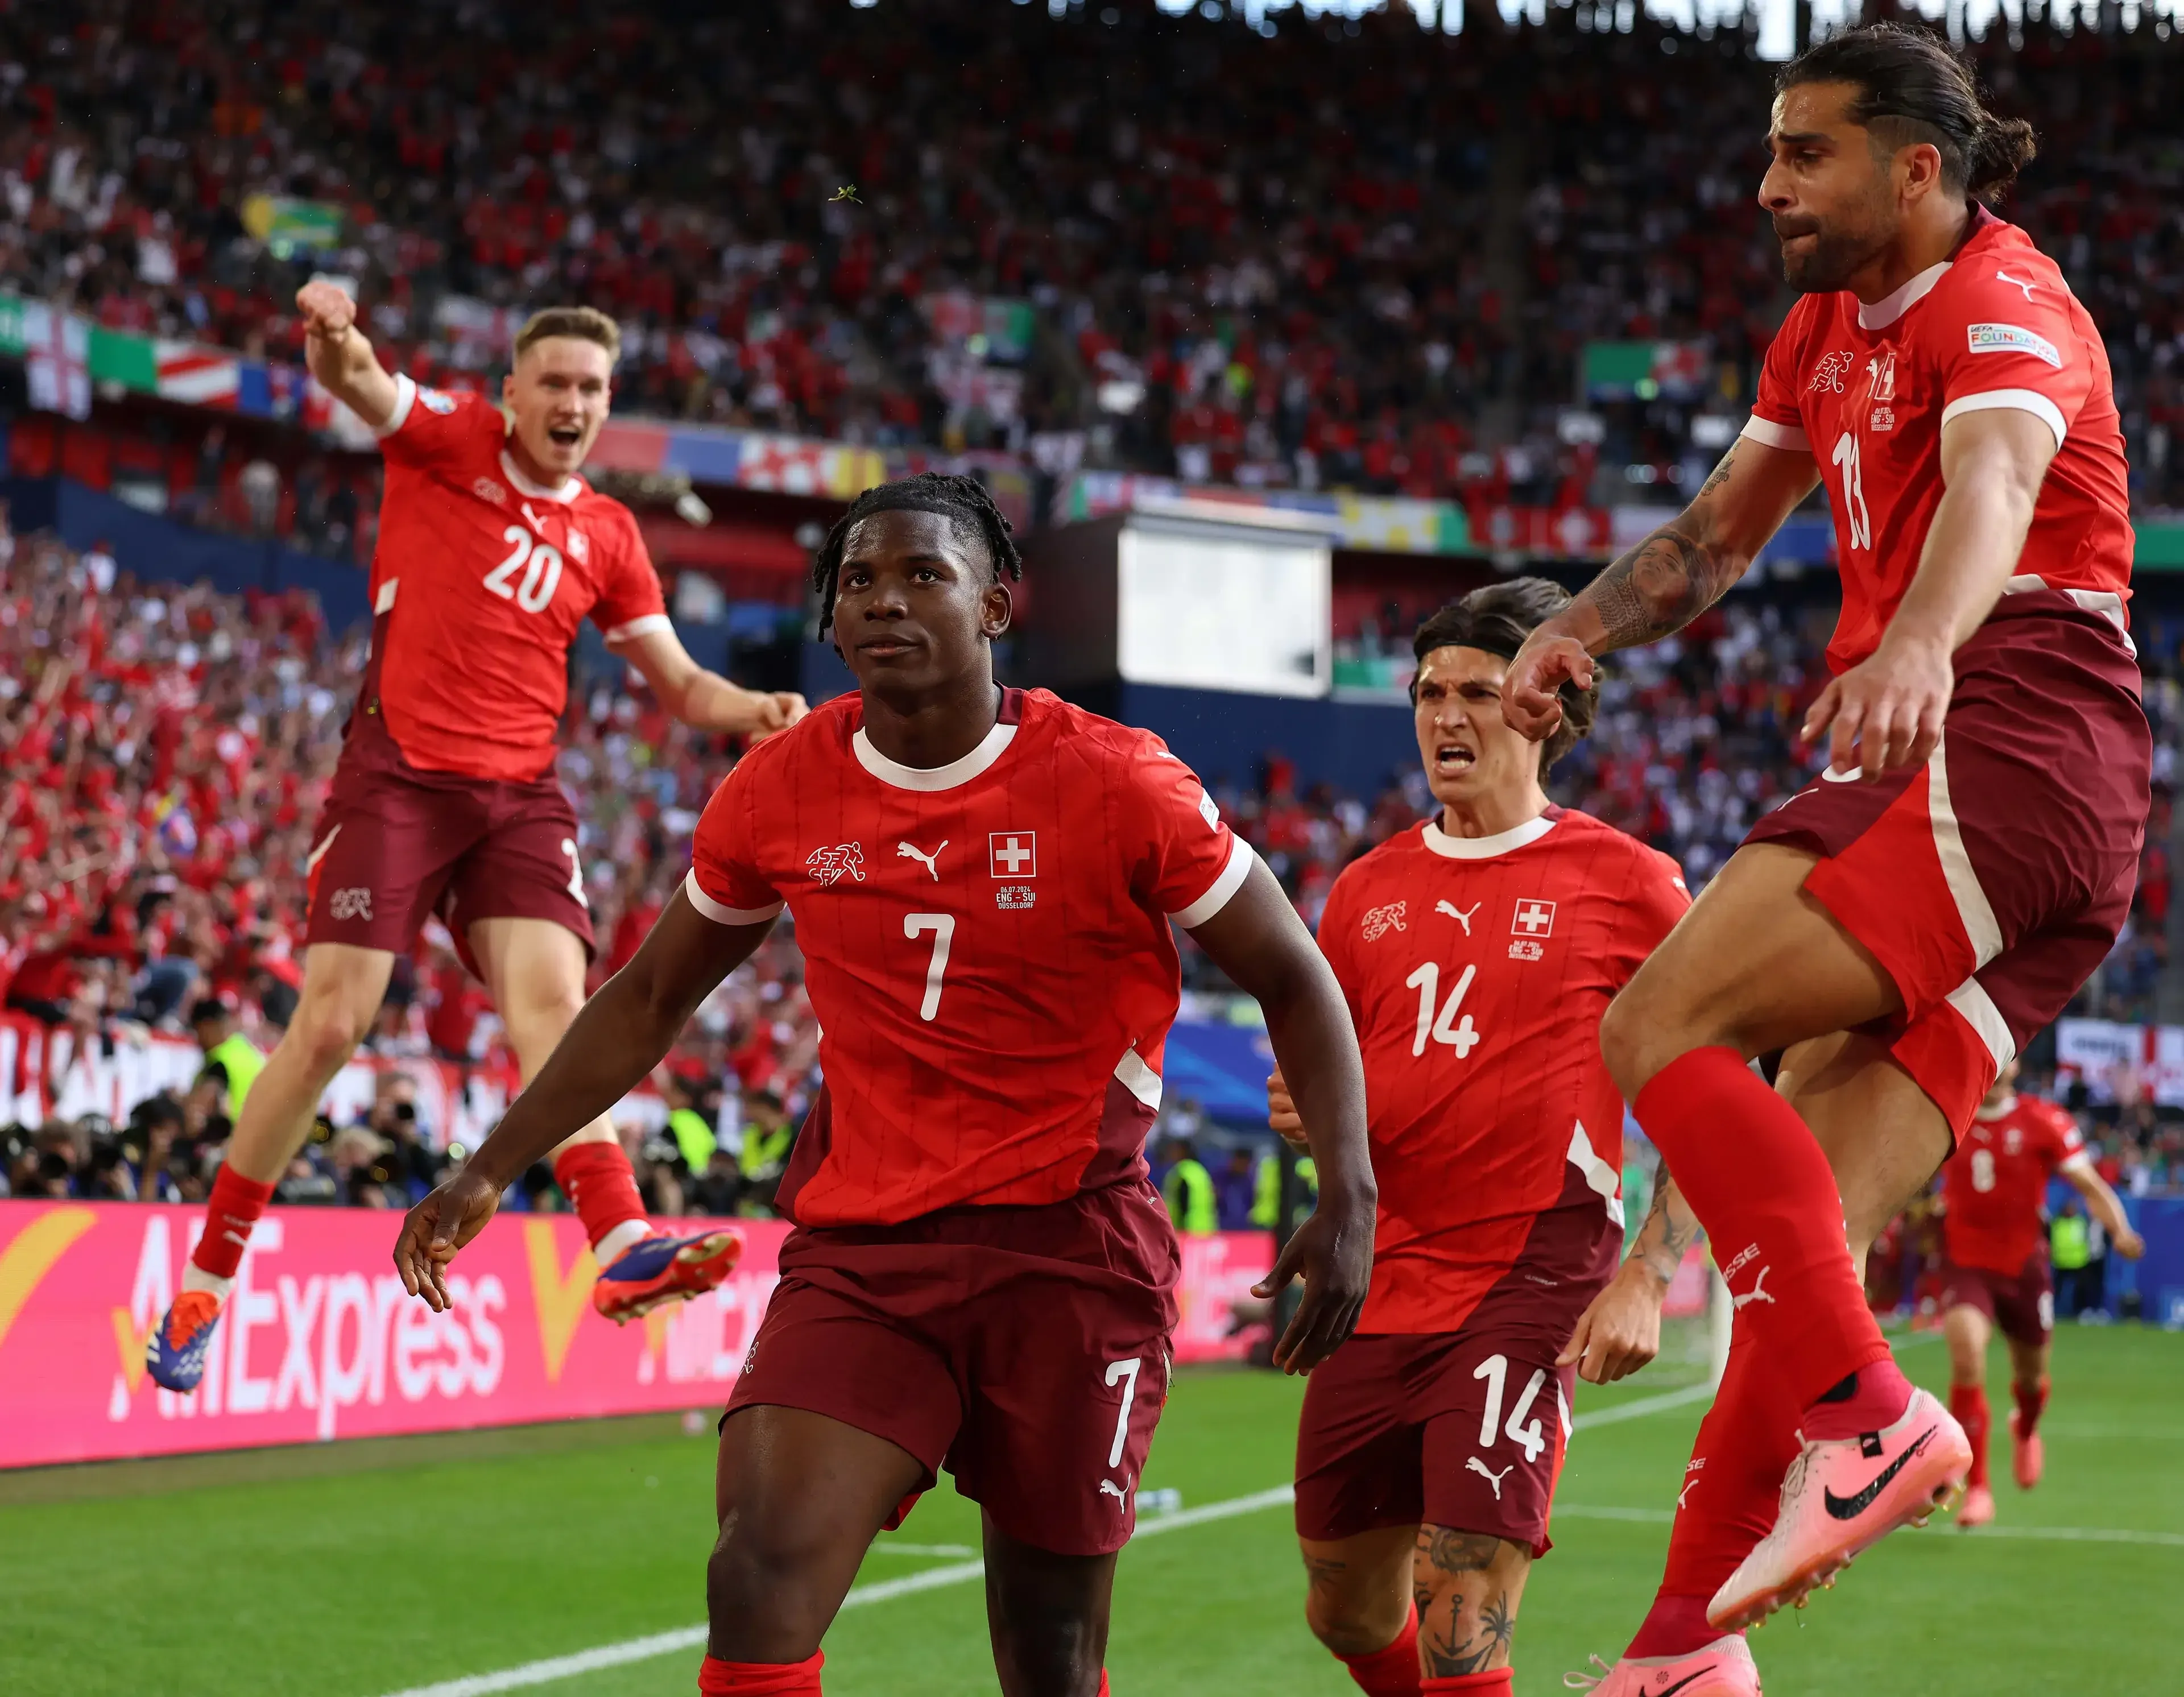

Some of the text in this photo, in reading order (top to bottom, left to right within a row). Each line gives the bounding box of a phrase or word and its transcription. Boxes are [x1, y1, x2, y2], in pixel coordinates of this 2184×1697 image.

[1871, 414, 1881, 424] ENG
[1885, 414, 1895, 423] SUI
[1832, 432, 1871, 551] 13
[483, 524, 563, 614] 20
[996, 893, 1012, 903] ENG
[1023, 892, 1035, 901] SUI
[904, 913, 956, 1021] 7
[1405, 961, 1480, 1059] 14
[1105, 1357, 1141, 1468] 7
[1473, 1354, 1546, 1463] 14
